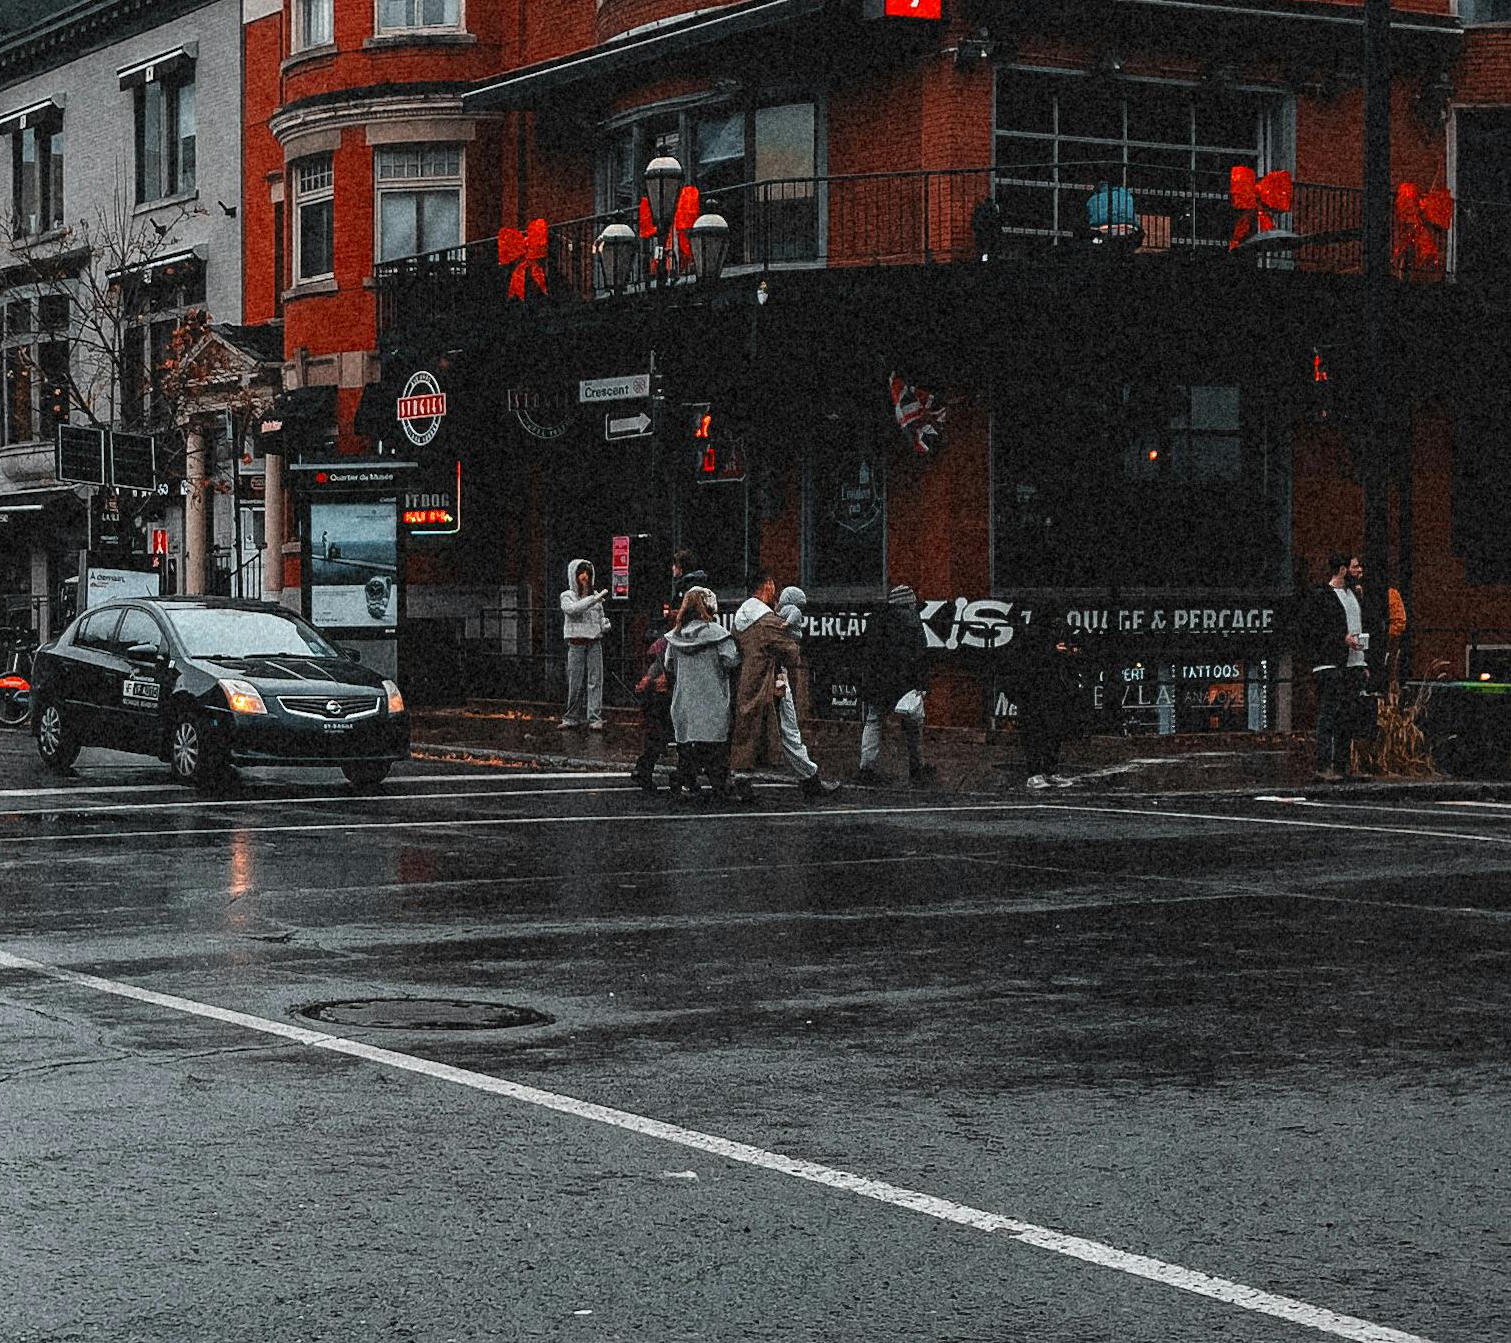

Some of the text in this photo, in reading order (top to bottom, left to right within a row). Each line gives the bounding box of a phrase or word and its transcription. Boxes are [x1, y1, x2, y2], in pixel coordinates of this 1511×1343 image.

[584, 384, 629, 398] Crescent
[1173, 609, 1274, 638] PERÇAGE
[1182, 663, 1241, 679] TATTOOS
